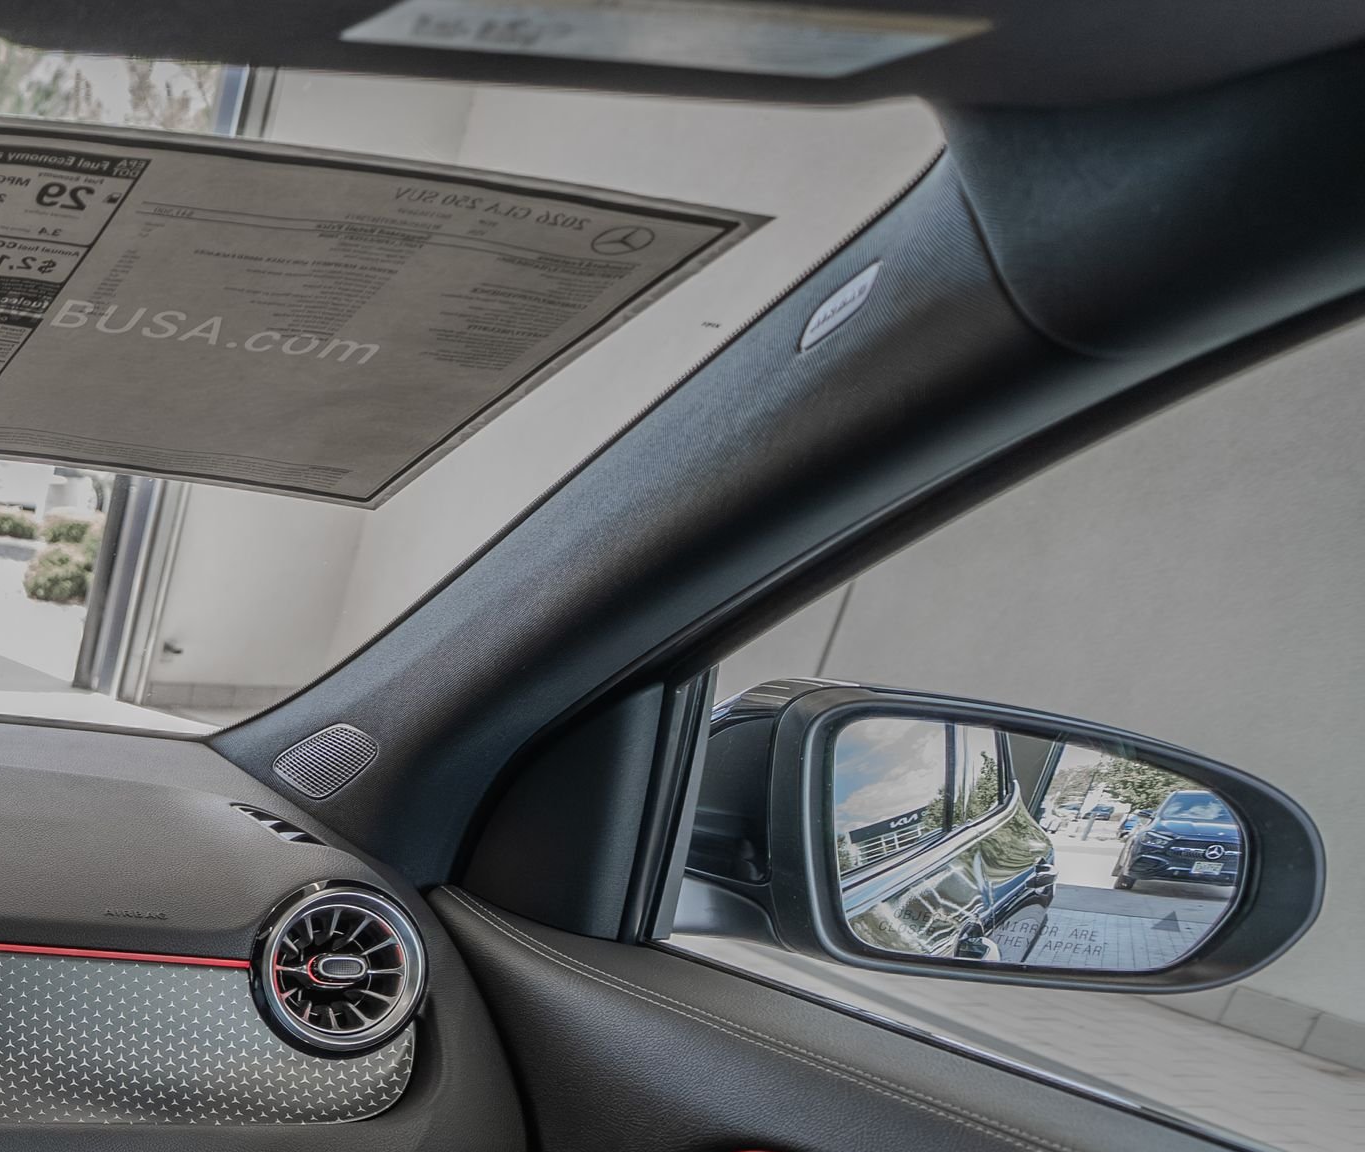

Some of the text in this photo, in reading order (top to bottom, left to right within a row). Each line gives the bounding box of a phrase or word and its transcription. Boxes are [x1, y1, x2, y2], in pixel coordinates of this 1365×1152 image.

[1000, 920, 1058, 937] MIRROR
[1068, 929, 1097, 942] ARE
[996, 933, 1031, 948] THEY
[1043, 942, 1103, 955] APPEAR
